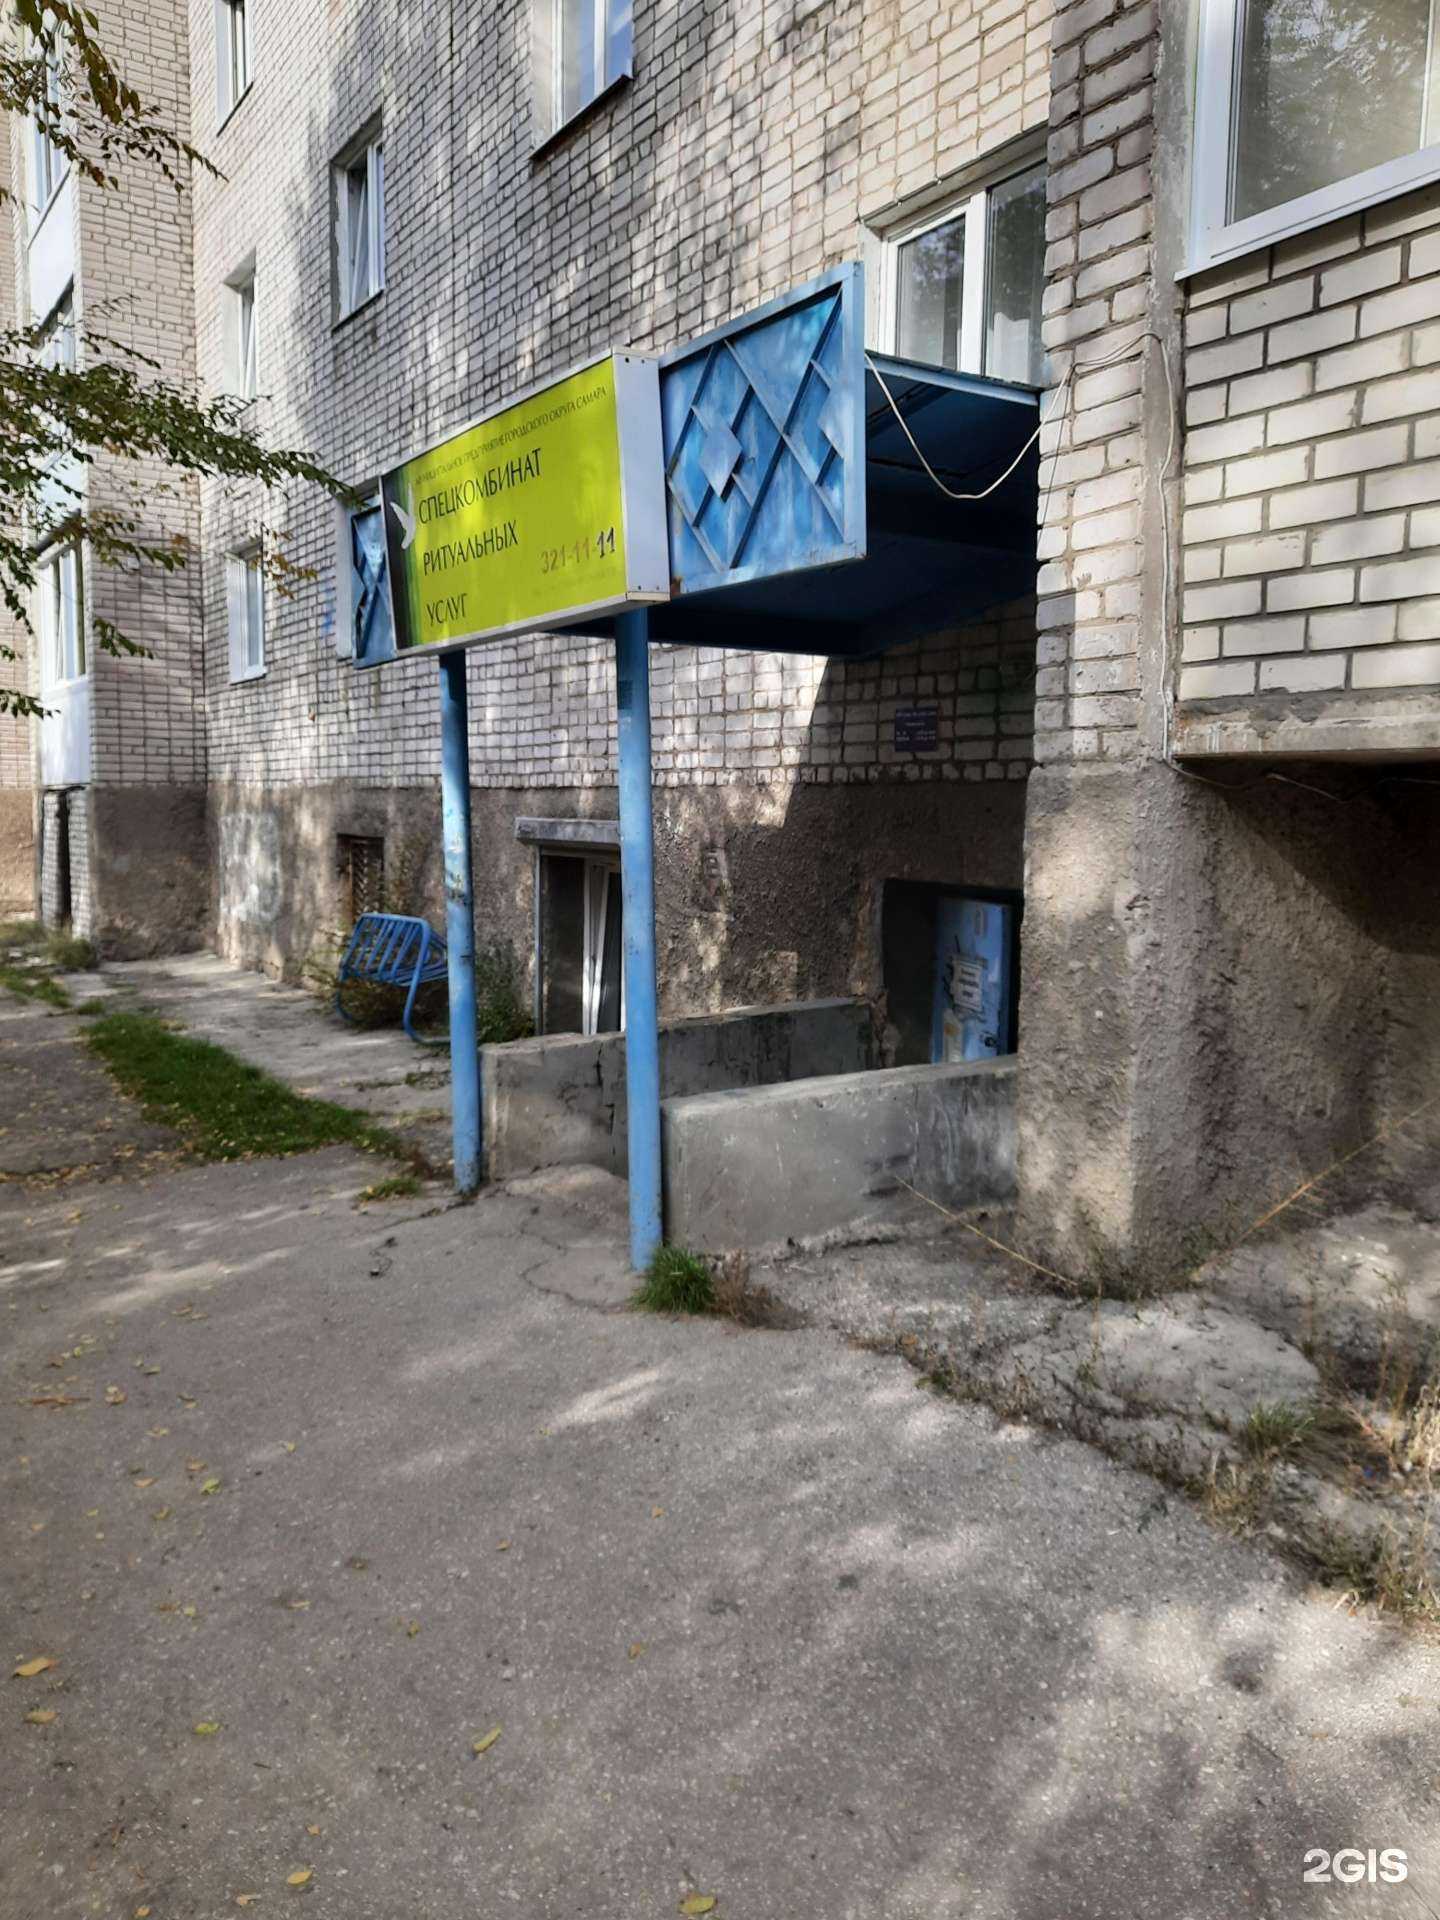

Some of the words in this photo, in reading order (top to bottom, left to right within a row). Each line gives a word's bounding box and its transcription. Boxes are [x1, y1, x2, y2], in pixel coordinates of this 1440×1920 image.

[576, 385, 608, 409] САМАРА
[418, 448, 541, 524] СПЕЦКОМБИНАТ
[423, 519, 519, 576] РИТУАЛЬНЫХ
[541, 526, 616, 575] 321-11-11
[427, 592, 468, 627] УСЛУГ
